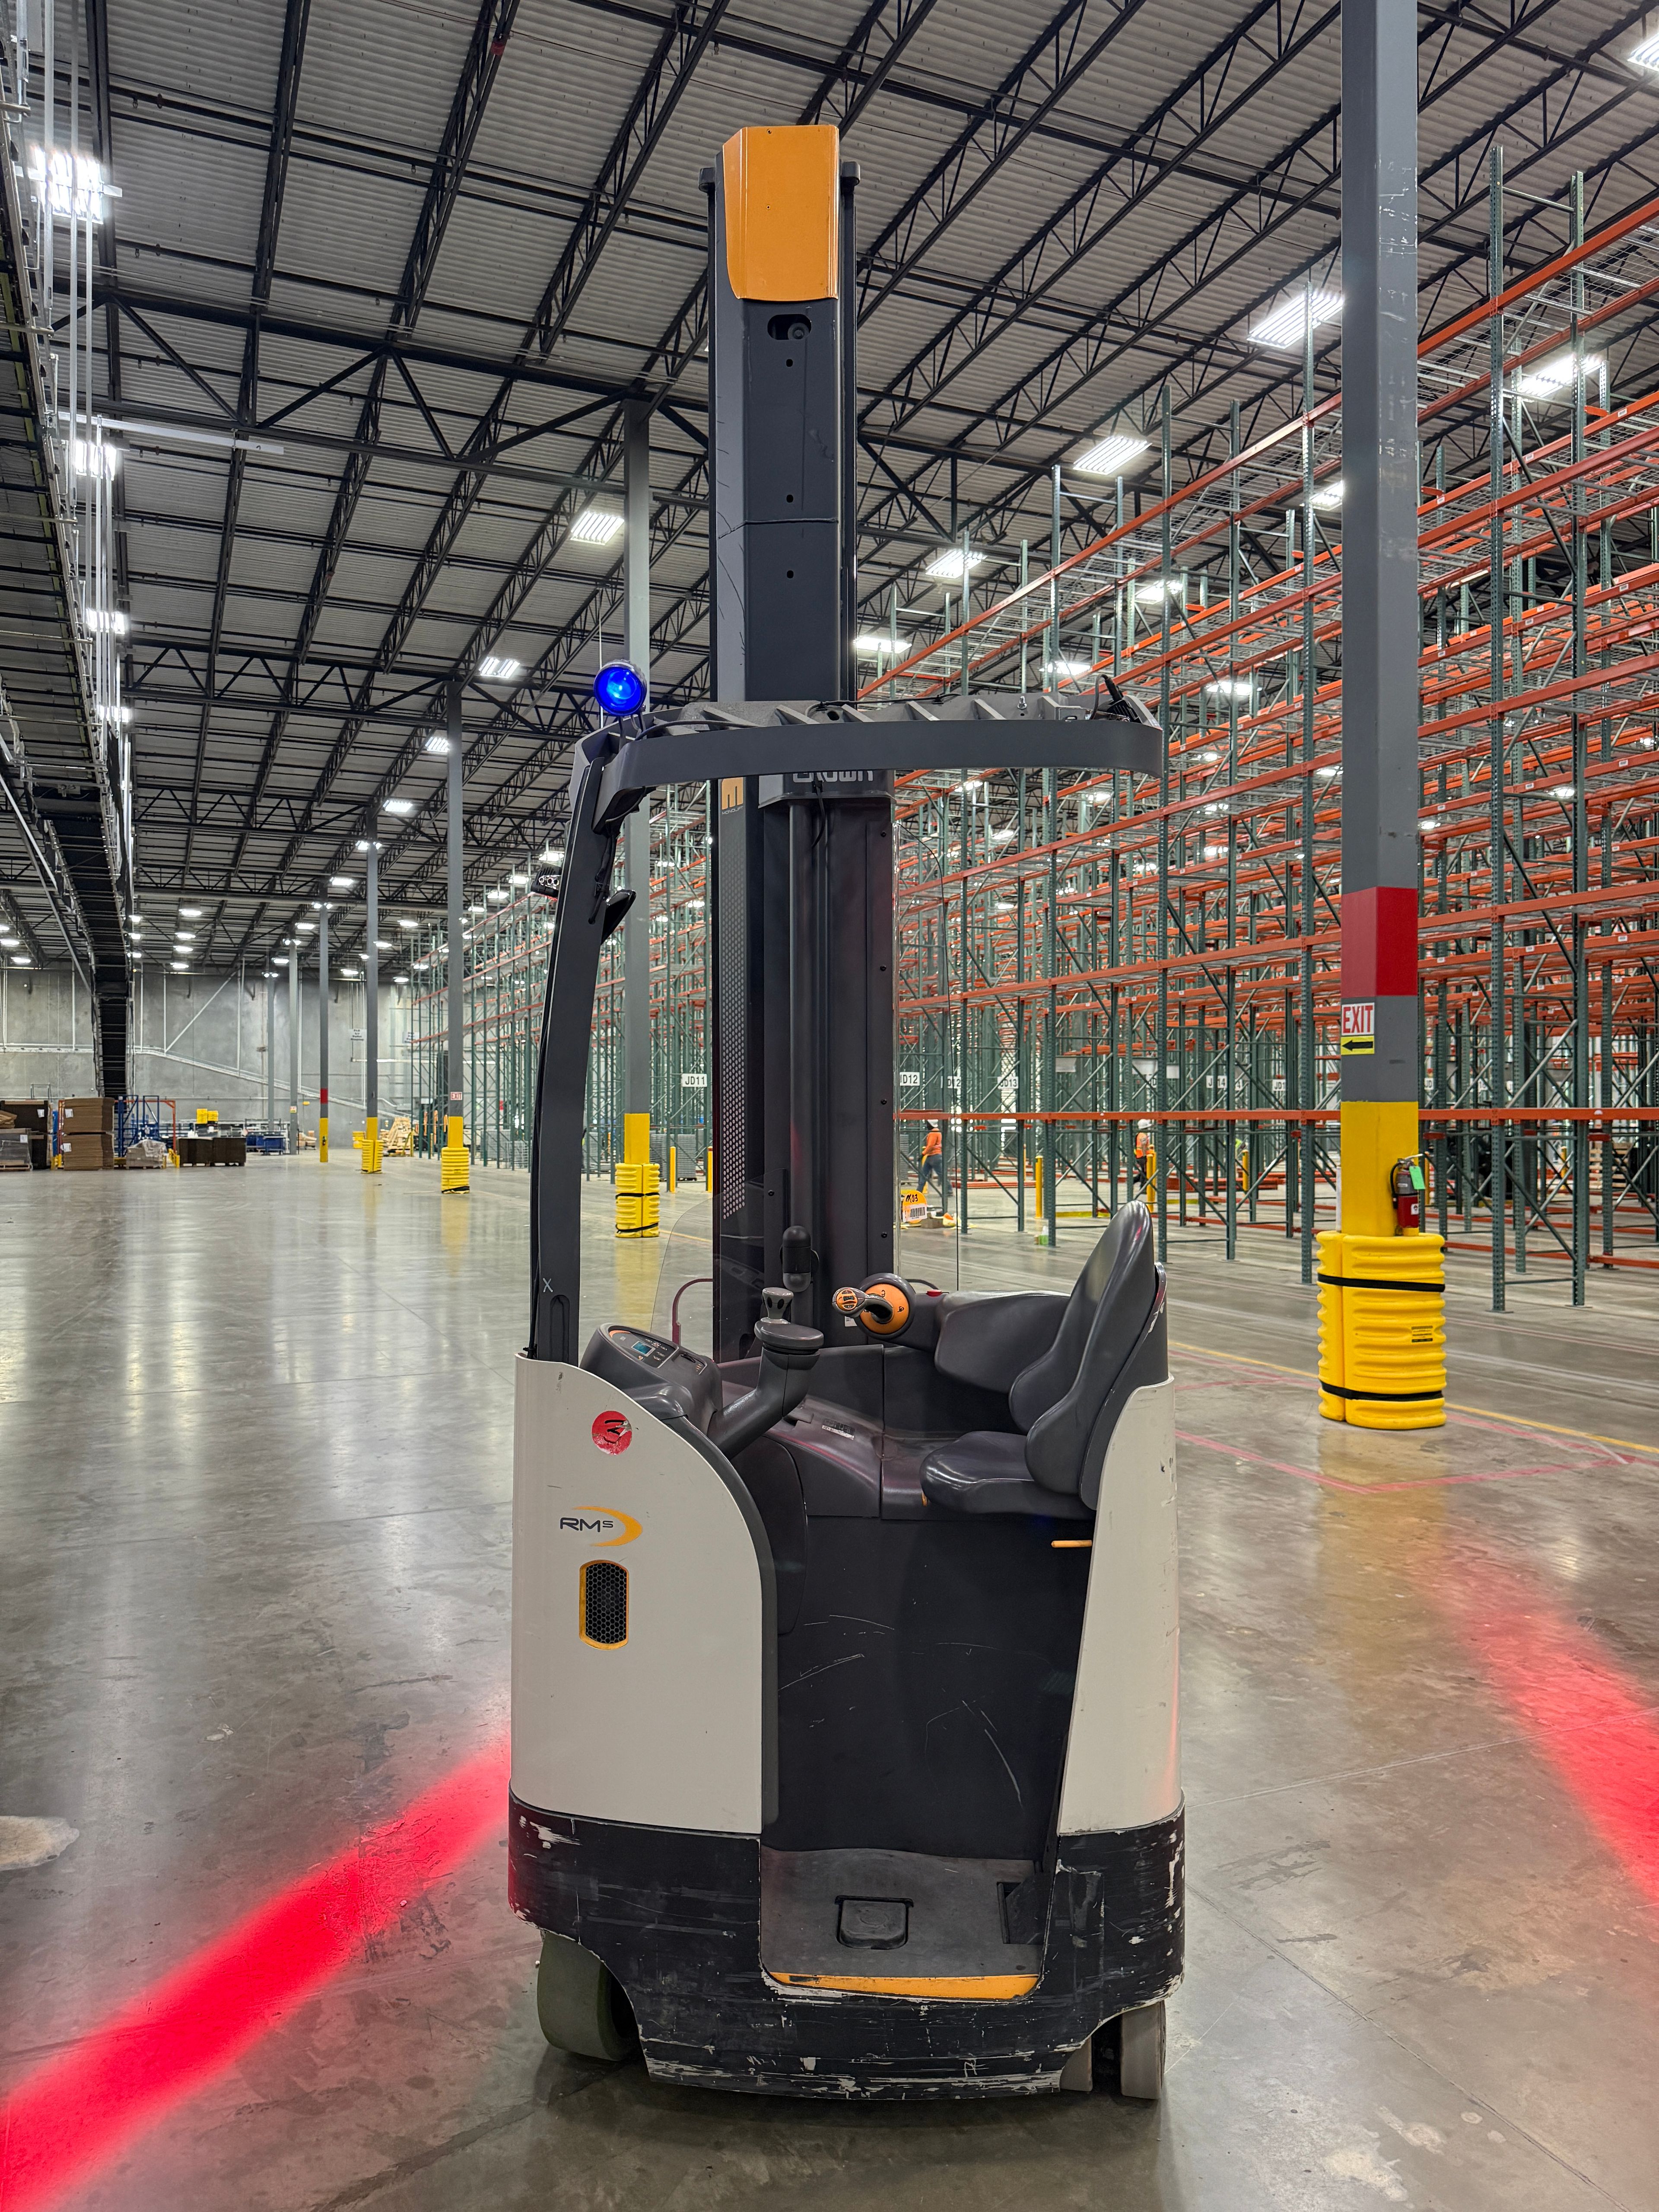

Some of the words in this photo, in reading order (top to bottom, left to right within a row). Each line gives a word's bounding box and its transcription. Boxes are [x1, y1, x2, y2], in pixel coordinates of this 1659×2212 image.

[793, 771, 873, 782] COWN
[1343, 1005, 1373, 1033] EXIT
[685, 1076, 705, 1085] JD11
[1274, 1081, 1285, 1090] JD1
